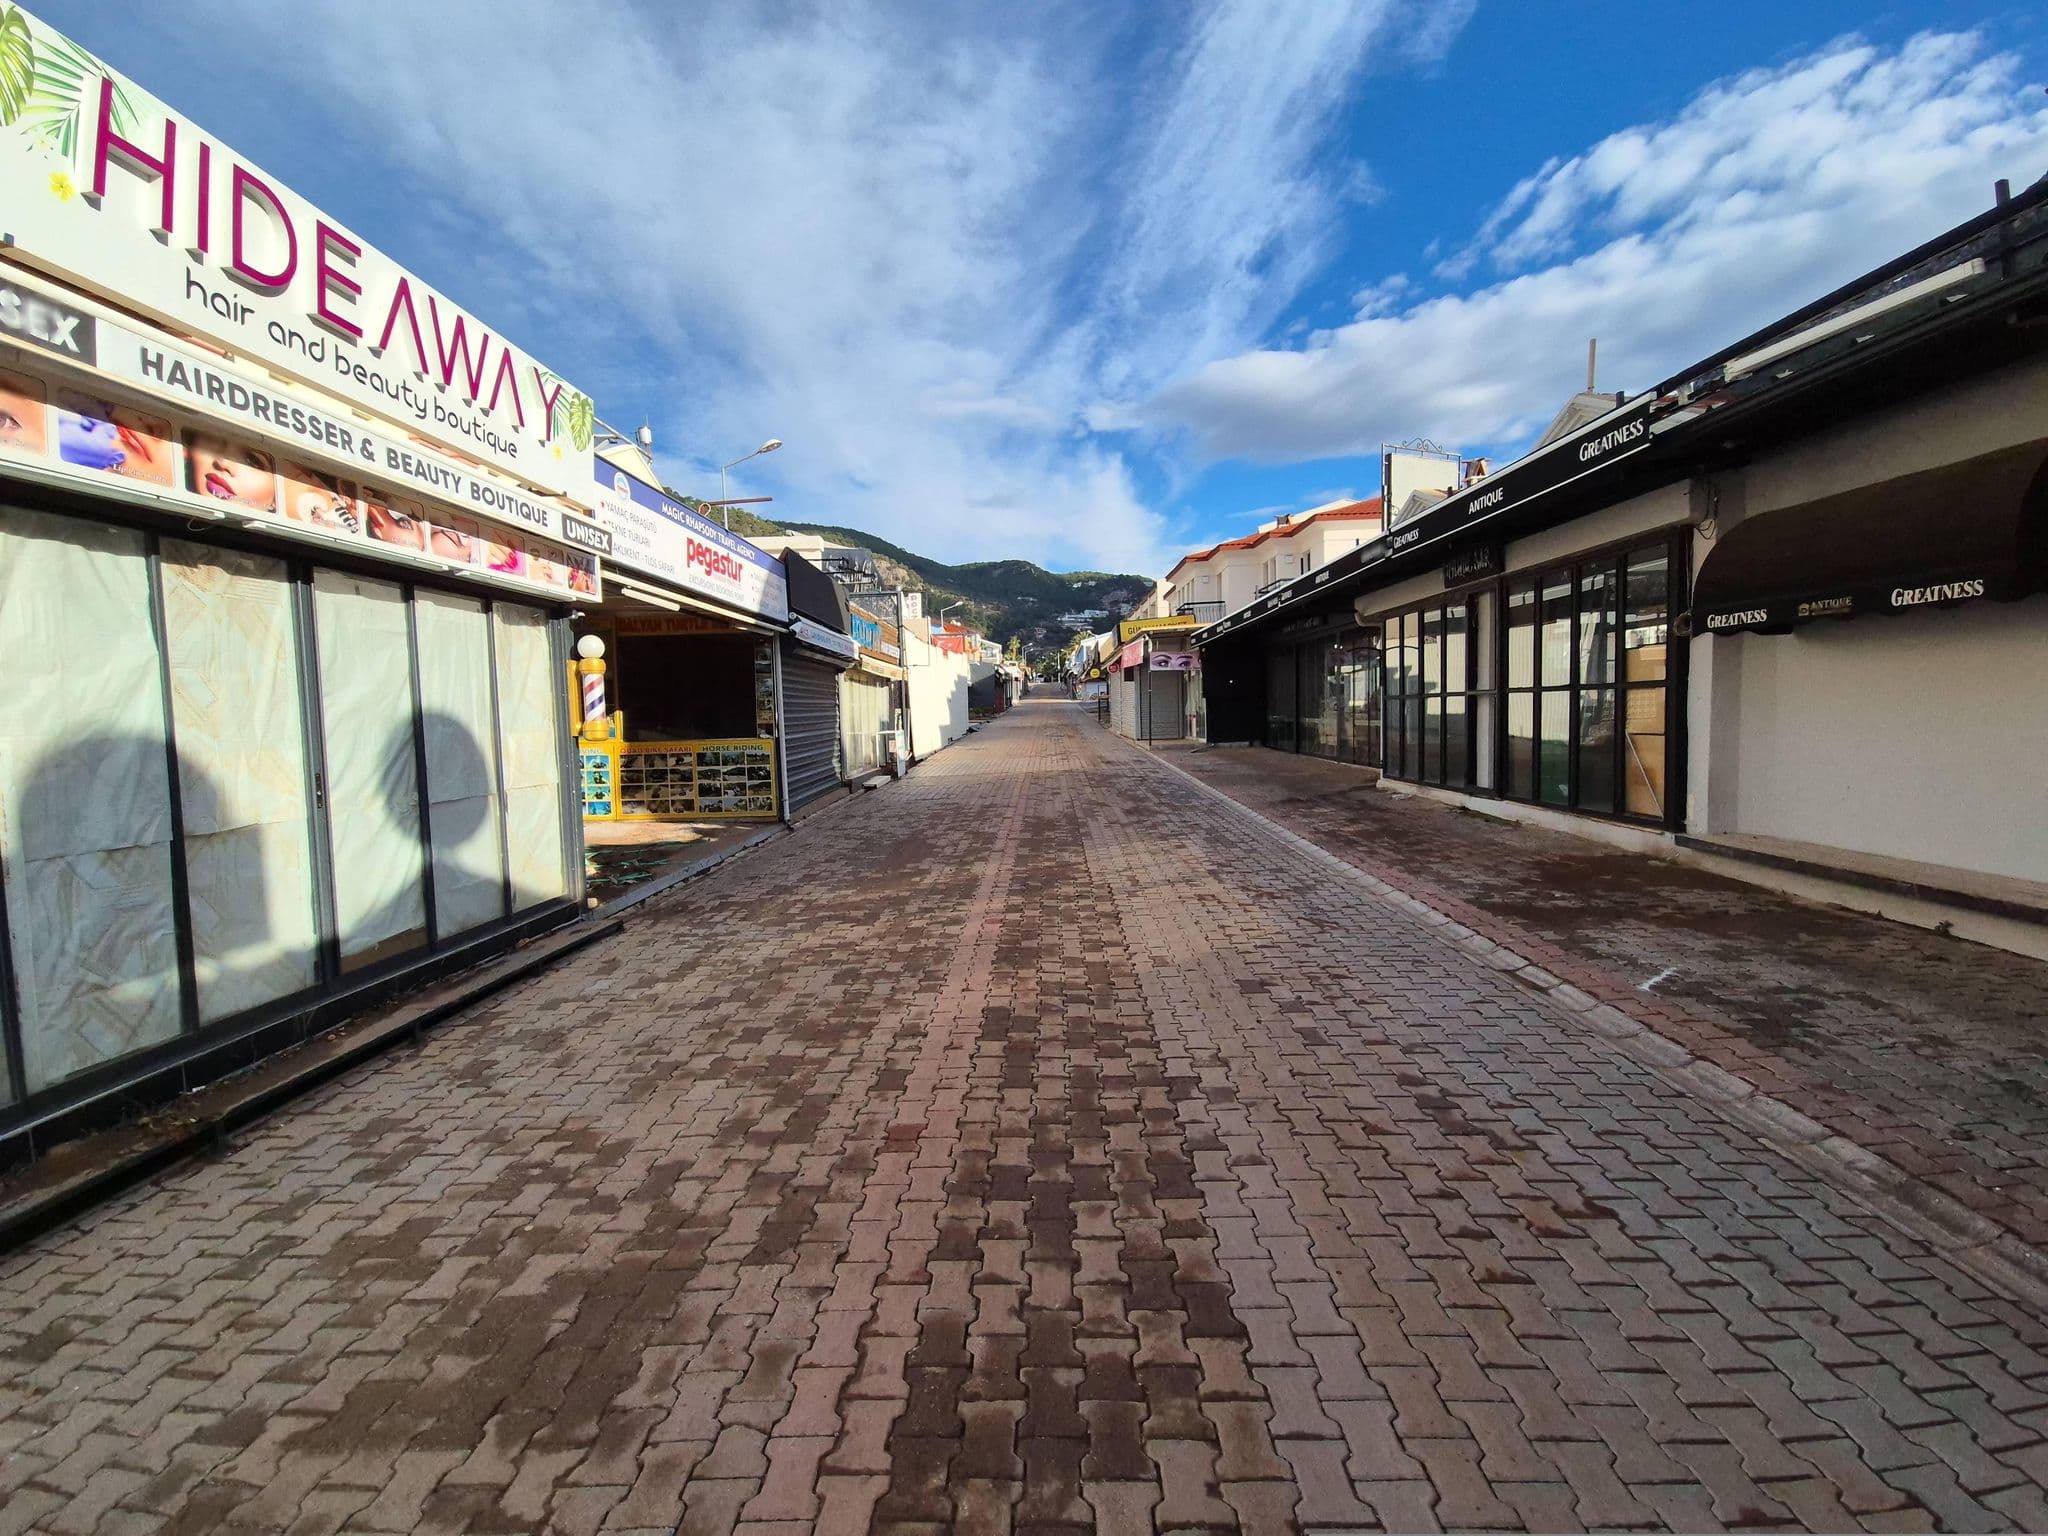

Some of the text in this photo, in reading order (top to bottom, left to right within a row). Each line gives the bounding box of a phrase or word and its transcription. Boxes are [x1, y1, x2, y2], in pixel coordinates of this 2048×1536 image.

[92, 77, 562, 442] HIDEAWAY
[186, 266, 518, 459] hair and beauty boutique
[140, 346, 549, 528] HAIRDRESSER & BEAUTY BOUTIQUE
[1579, 418, 1644, 462] GREATNESS
[1468, 487, 1504, 515] ANTIQUE
[566, 516, 610, 551] UNISEX
[661, 502, 756, 560] MAGIC RHAPSODY TRAVEL AGENCY
[1393, 528, 1420, 549] GREATNESS
[686, 537, 743, 582] pegastur
[1811, 596, 1853, 611] ANTIQUE
[1891, 579, 1985, 607] GREATNESS
[1706, 608, 1768, 630] GREATNESS
